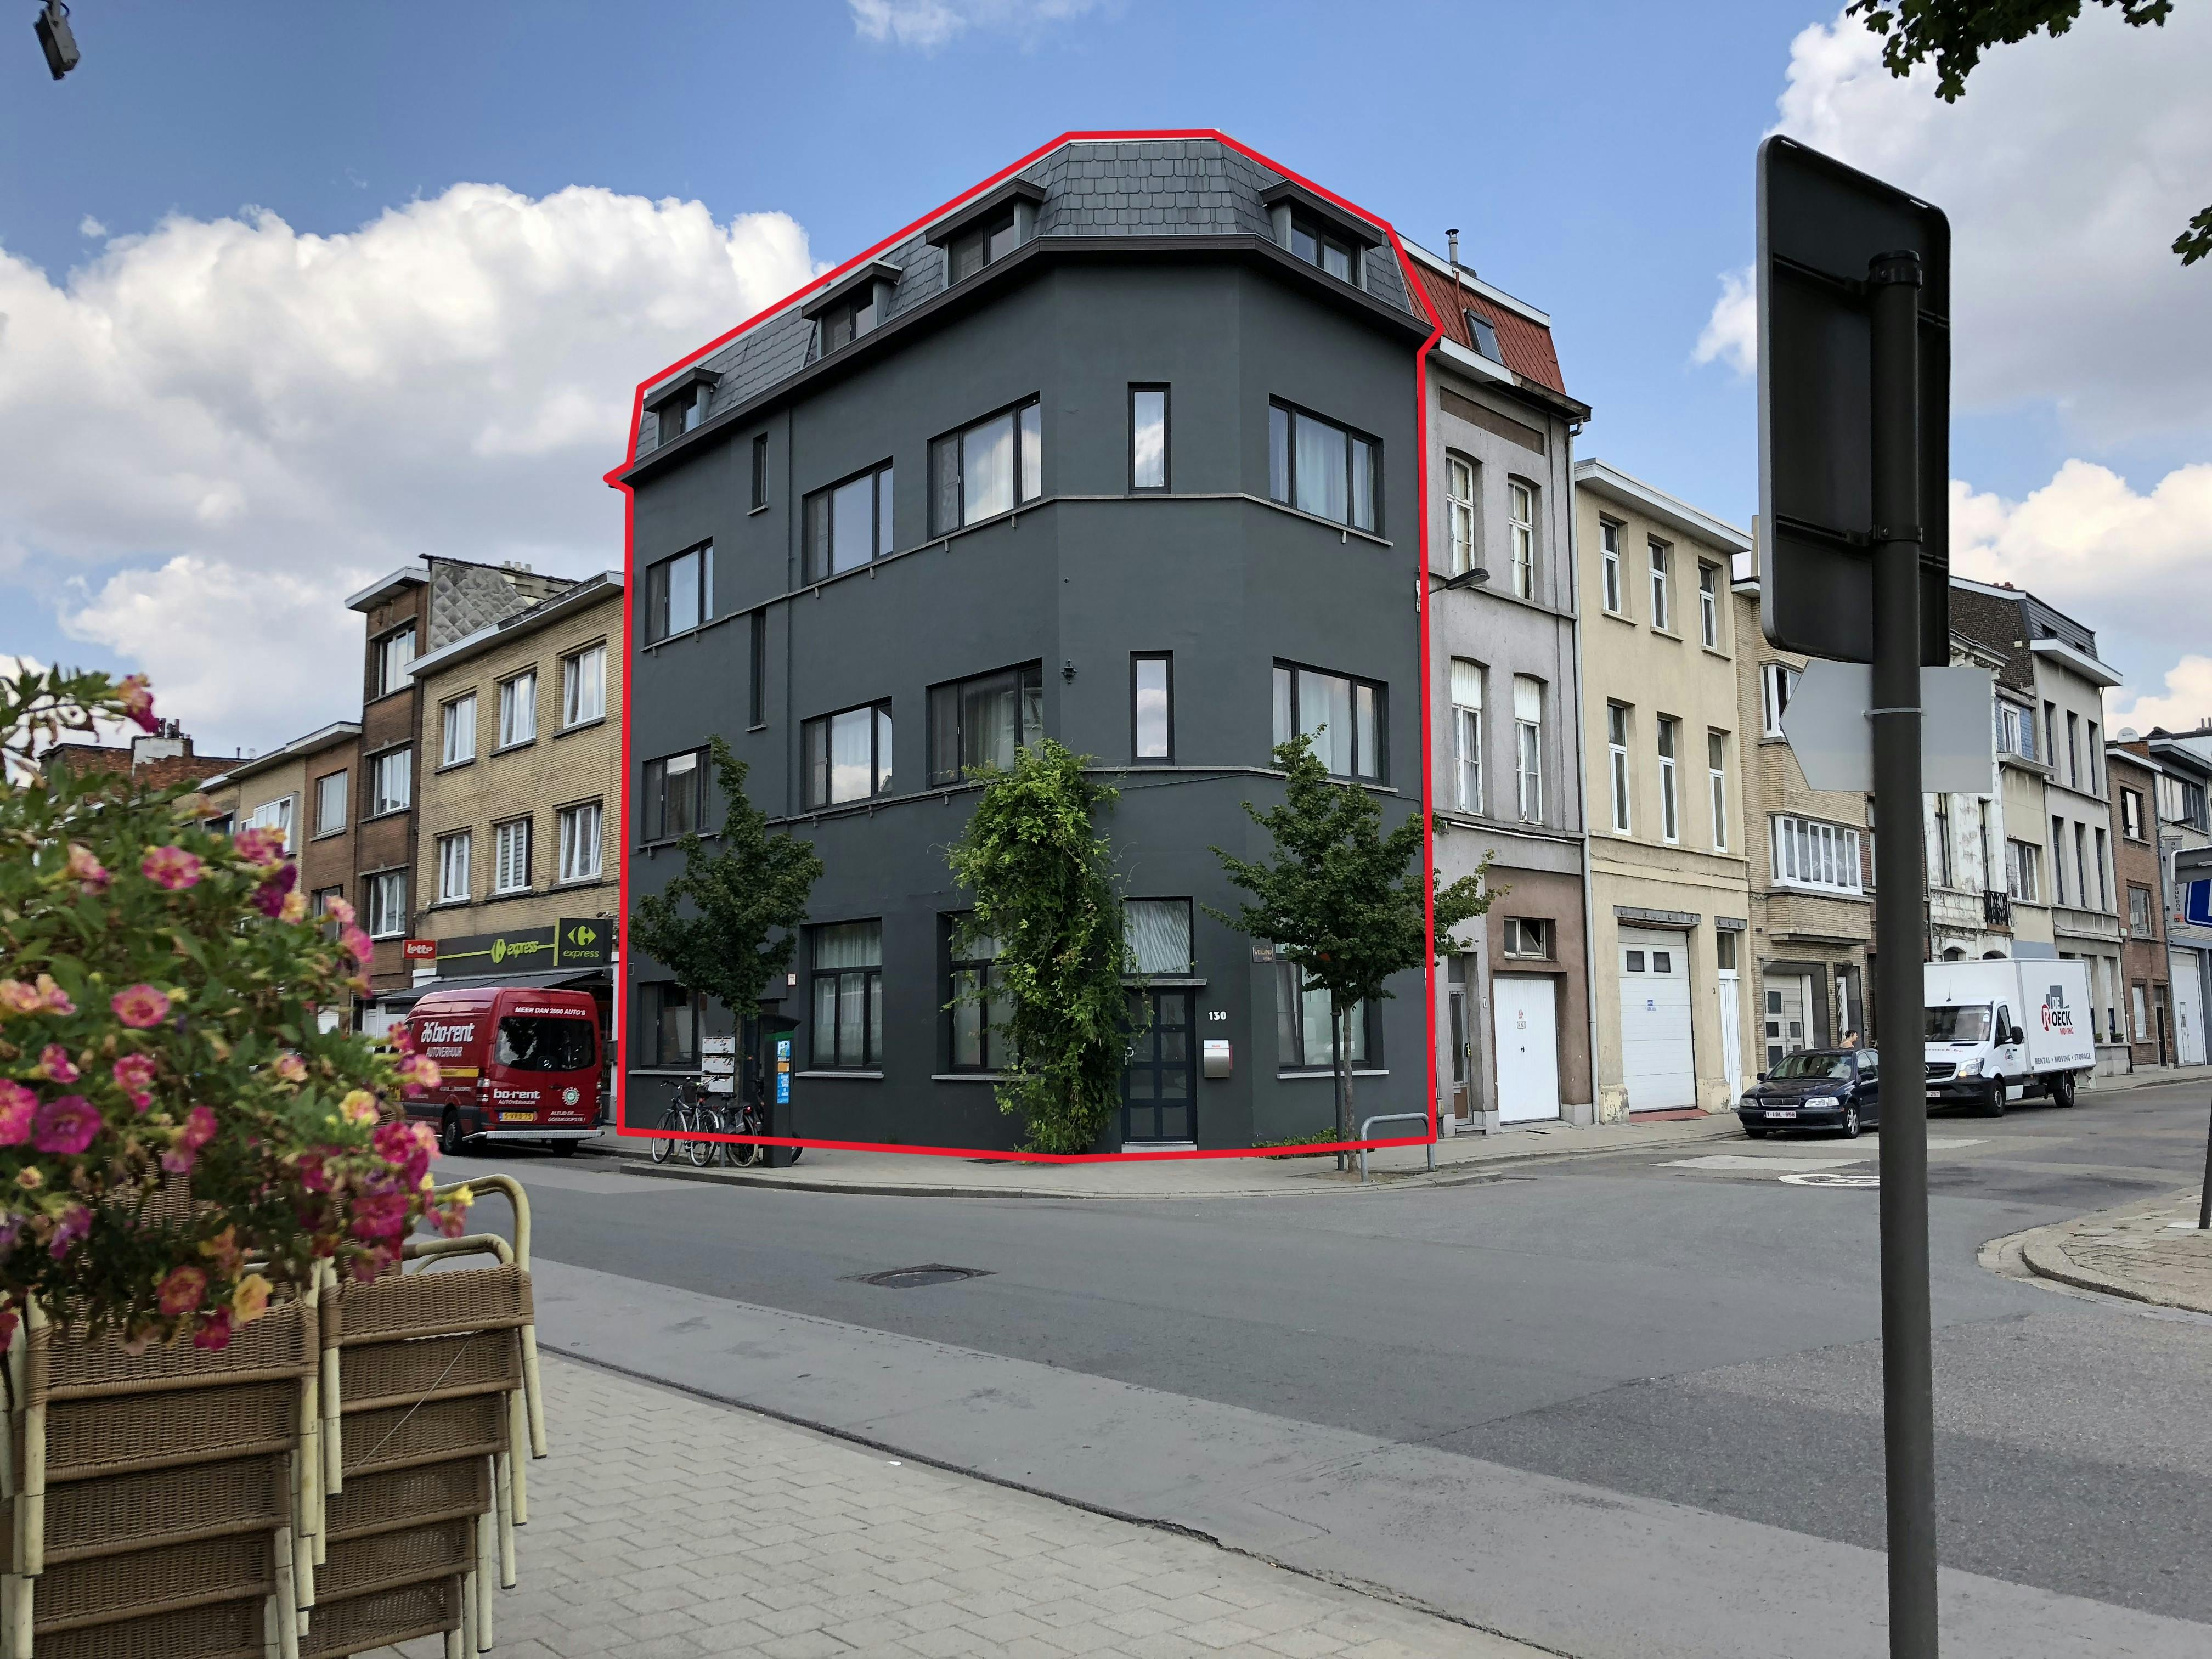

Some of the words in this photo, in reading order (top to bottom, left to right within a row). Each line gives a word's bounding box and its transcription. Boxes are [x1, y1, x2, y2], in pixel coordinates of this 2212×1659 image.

[507, 940, 539, 958] express
[563, 950, 600, 959] express
[2052, 996, 2061, 1009] DE
[1209, 1011, 1227, 1020] 130
[2041, 1007, 2073, 1030] ROECK
[432, 1022, 475, 1042] bo-rent
[2059, 1027, 2074, 1035] MOVING
[2035, 1057, 2051, 1065] RENTAL
[2054, 1054, 2071, 1063] MOVING
[2074, 1052, 2091, 1061] STORAGE
[493, 1088, 541, 1099] bo-rent
